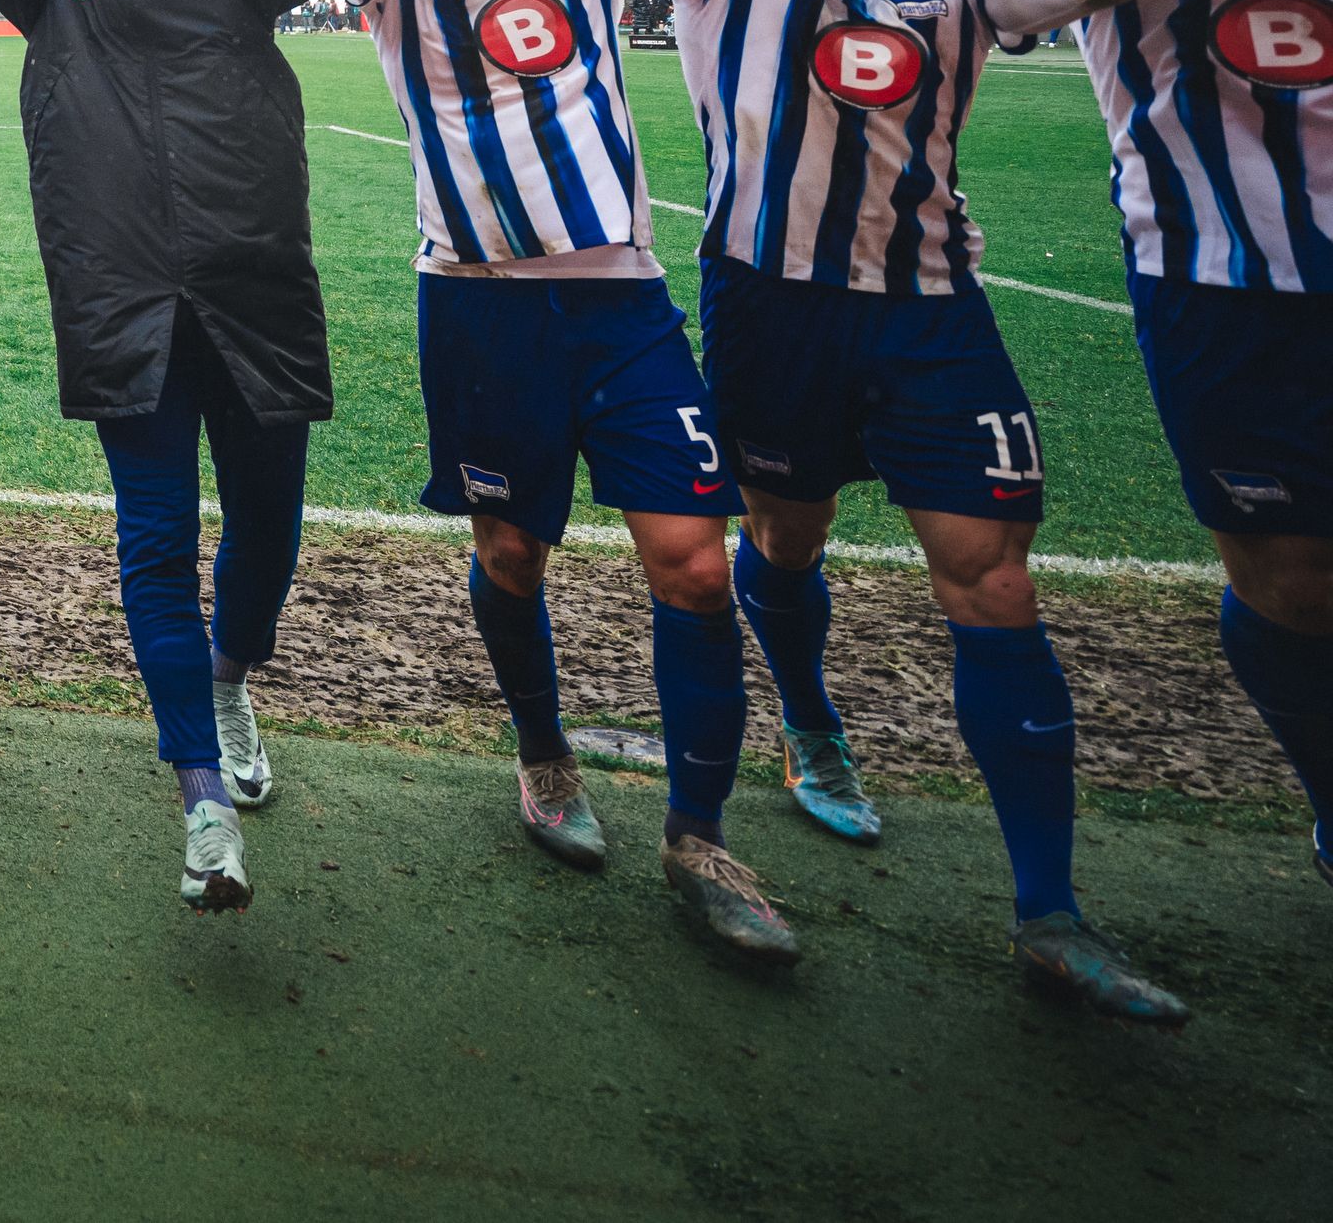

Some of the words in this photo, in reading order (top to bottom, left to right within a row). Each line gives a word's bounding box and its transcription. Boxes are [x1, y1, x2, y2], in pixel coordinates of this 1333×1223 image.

[496, 8, 556, 62] B
[840, 36, 895, 91] B
[1247, 10, 1324, 67] B
[677, 406, 719, 473] 5
[976, 411, 1043, 481] 11
